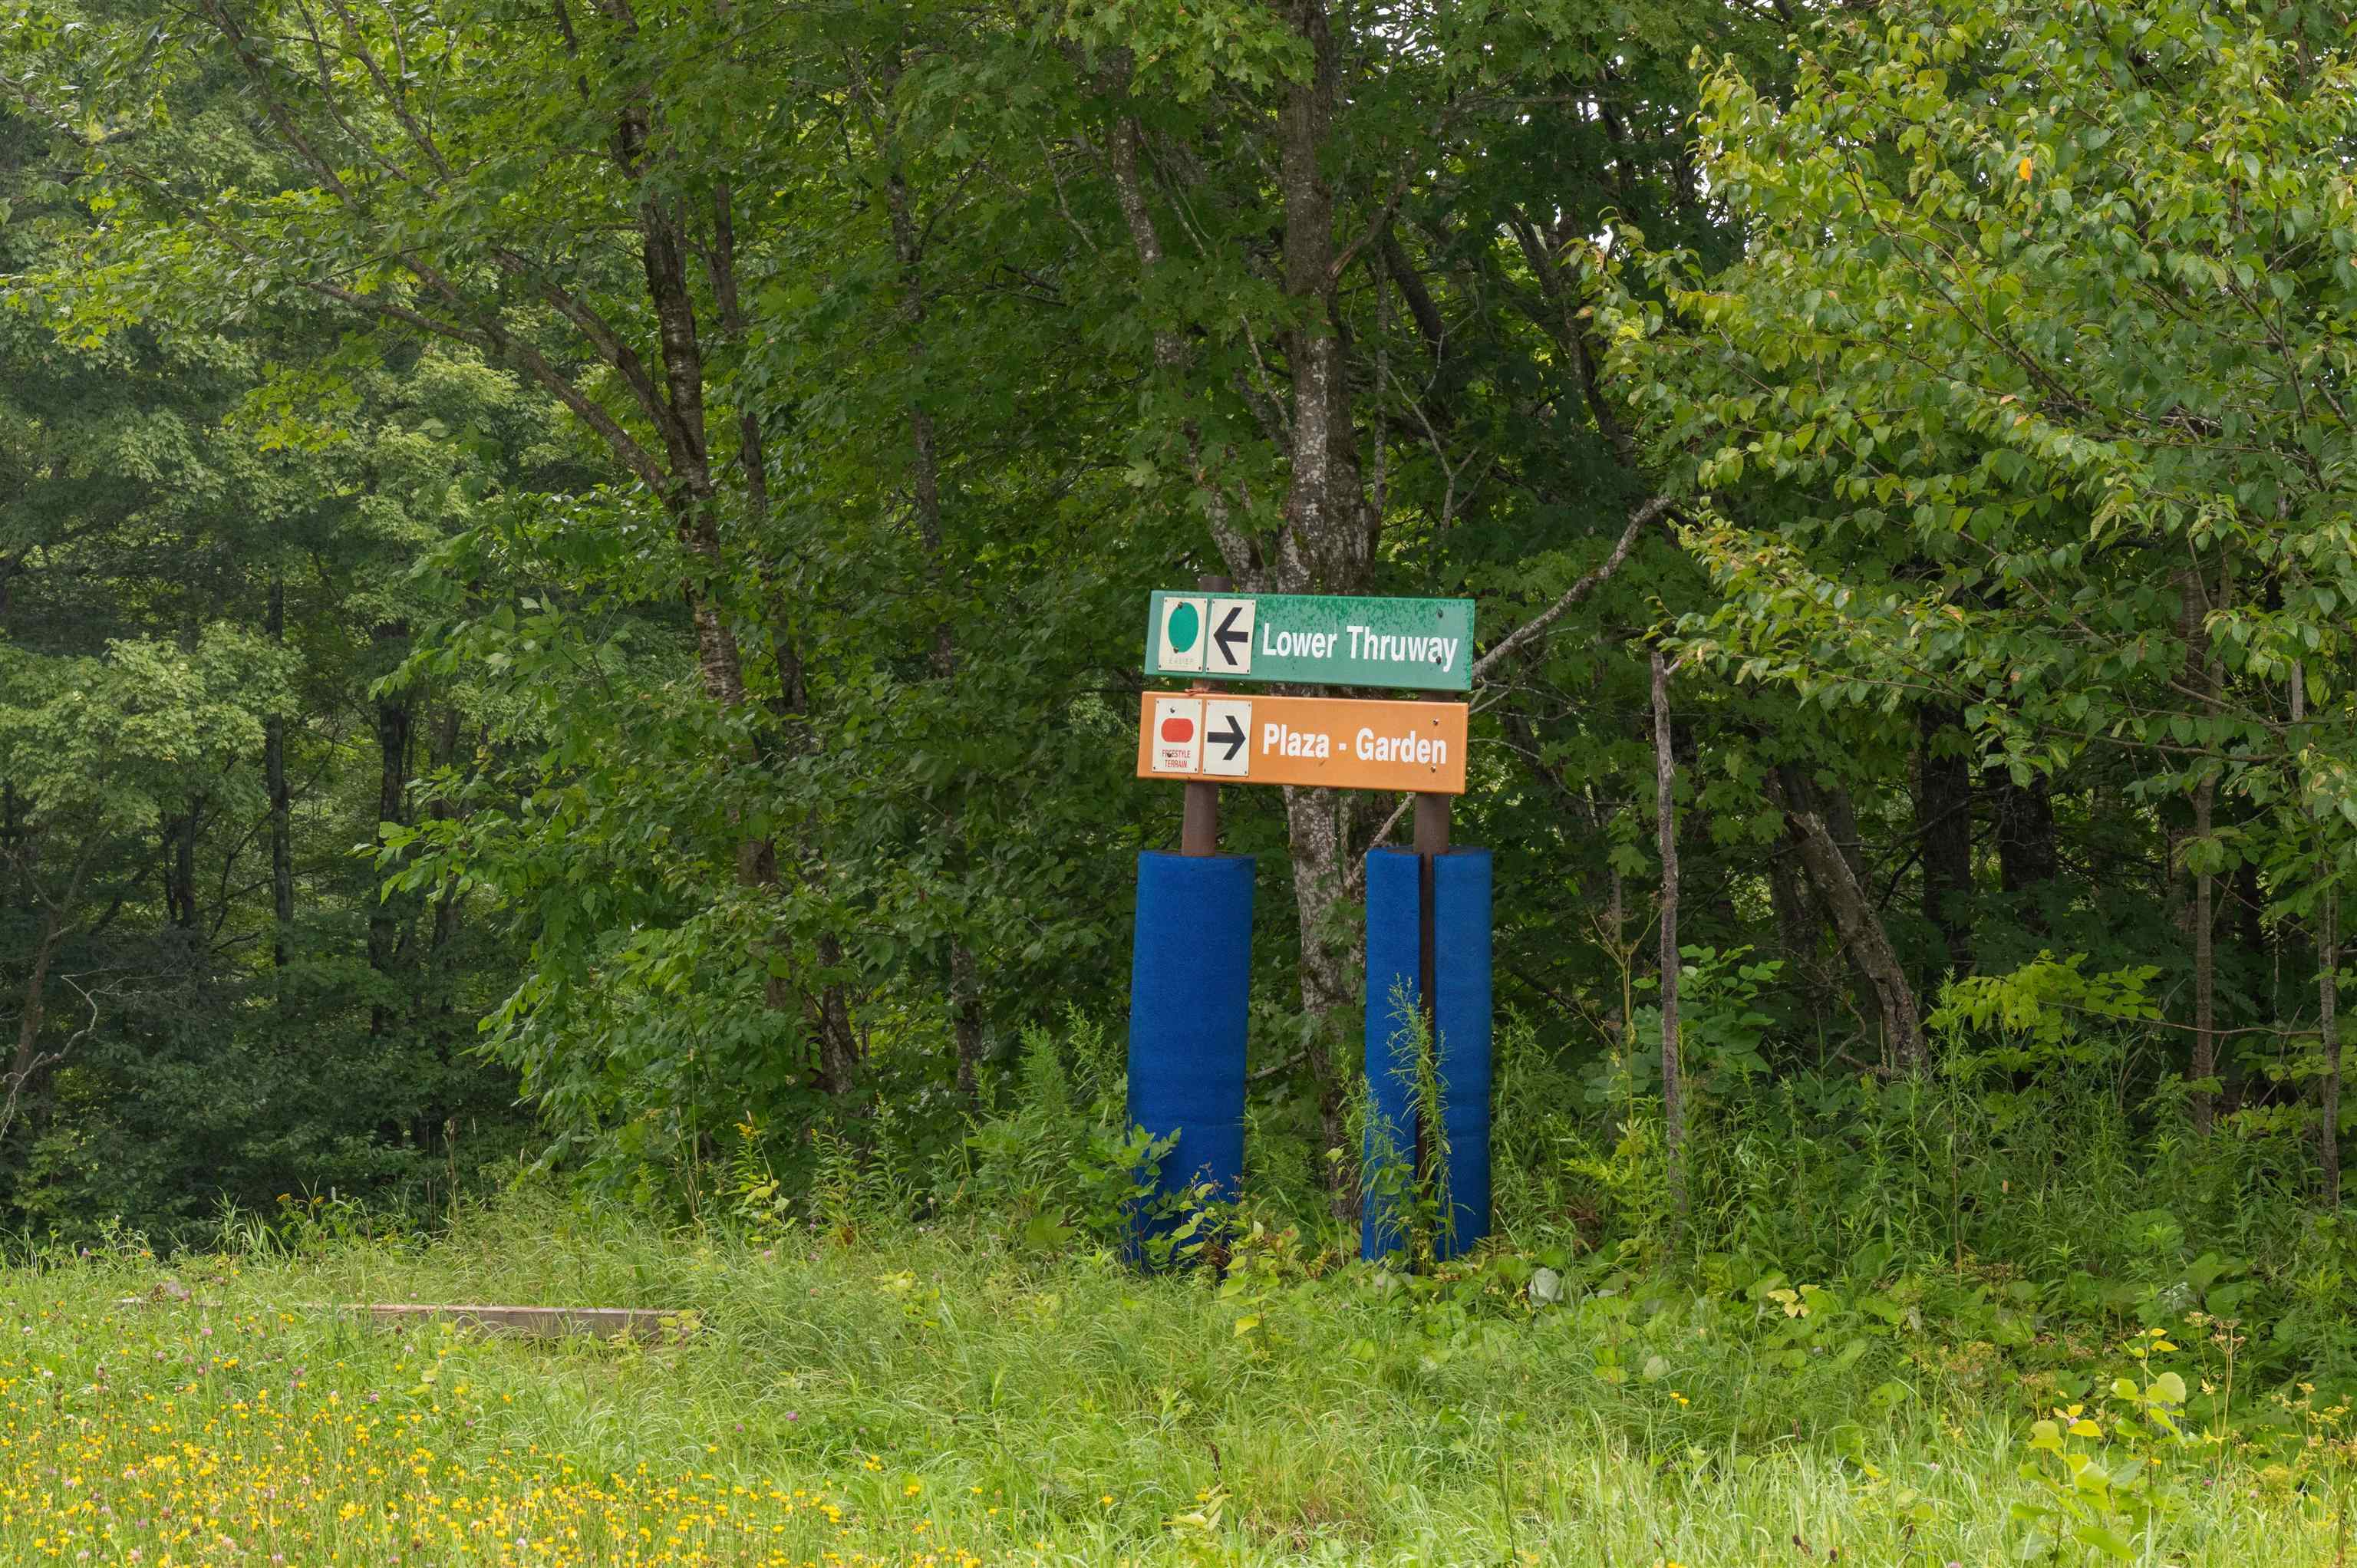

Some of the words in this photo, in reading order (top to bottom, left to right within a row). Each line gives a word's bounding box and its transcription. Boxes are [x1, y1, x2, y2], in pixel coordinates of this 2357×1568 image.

[1262, 622, 1338, 658] Lower
[1347, 625, 1458, 673] Thruway
[1165, 759, 1188, 768] TERRAIN
[1263, 723, 1330, 758] Plaza
[1356, 727, 1447, 764] Garden
